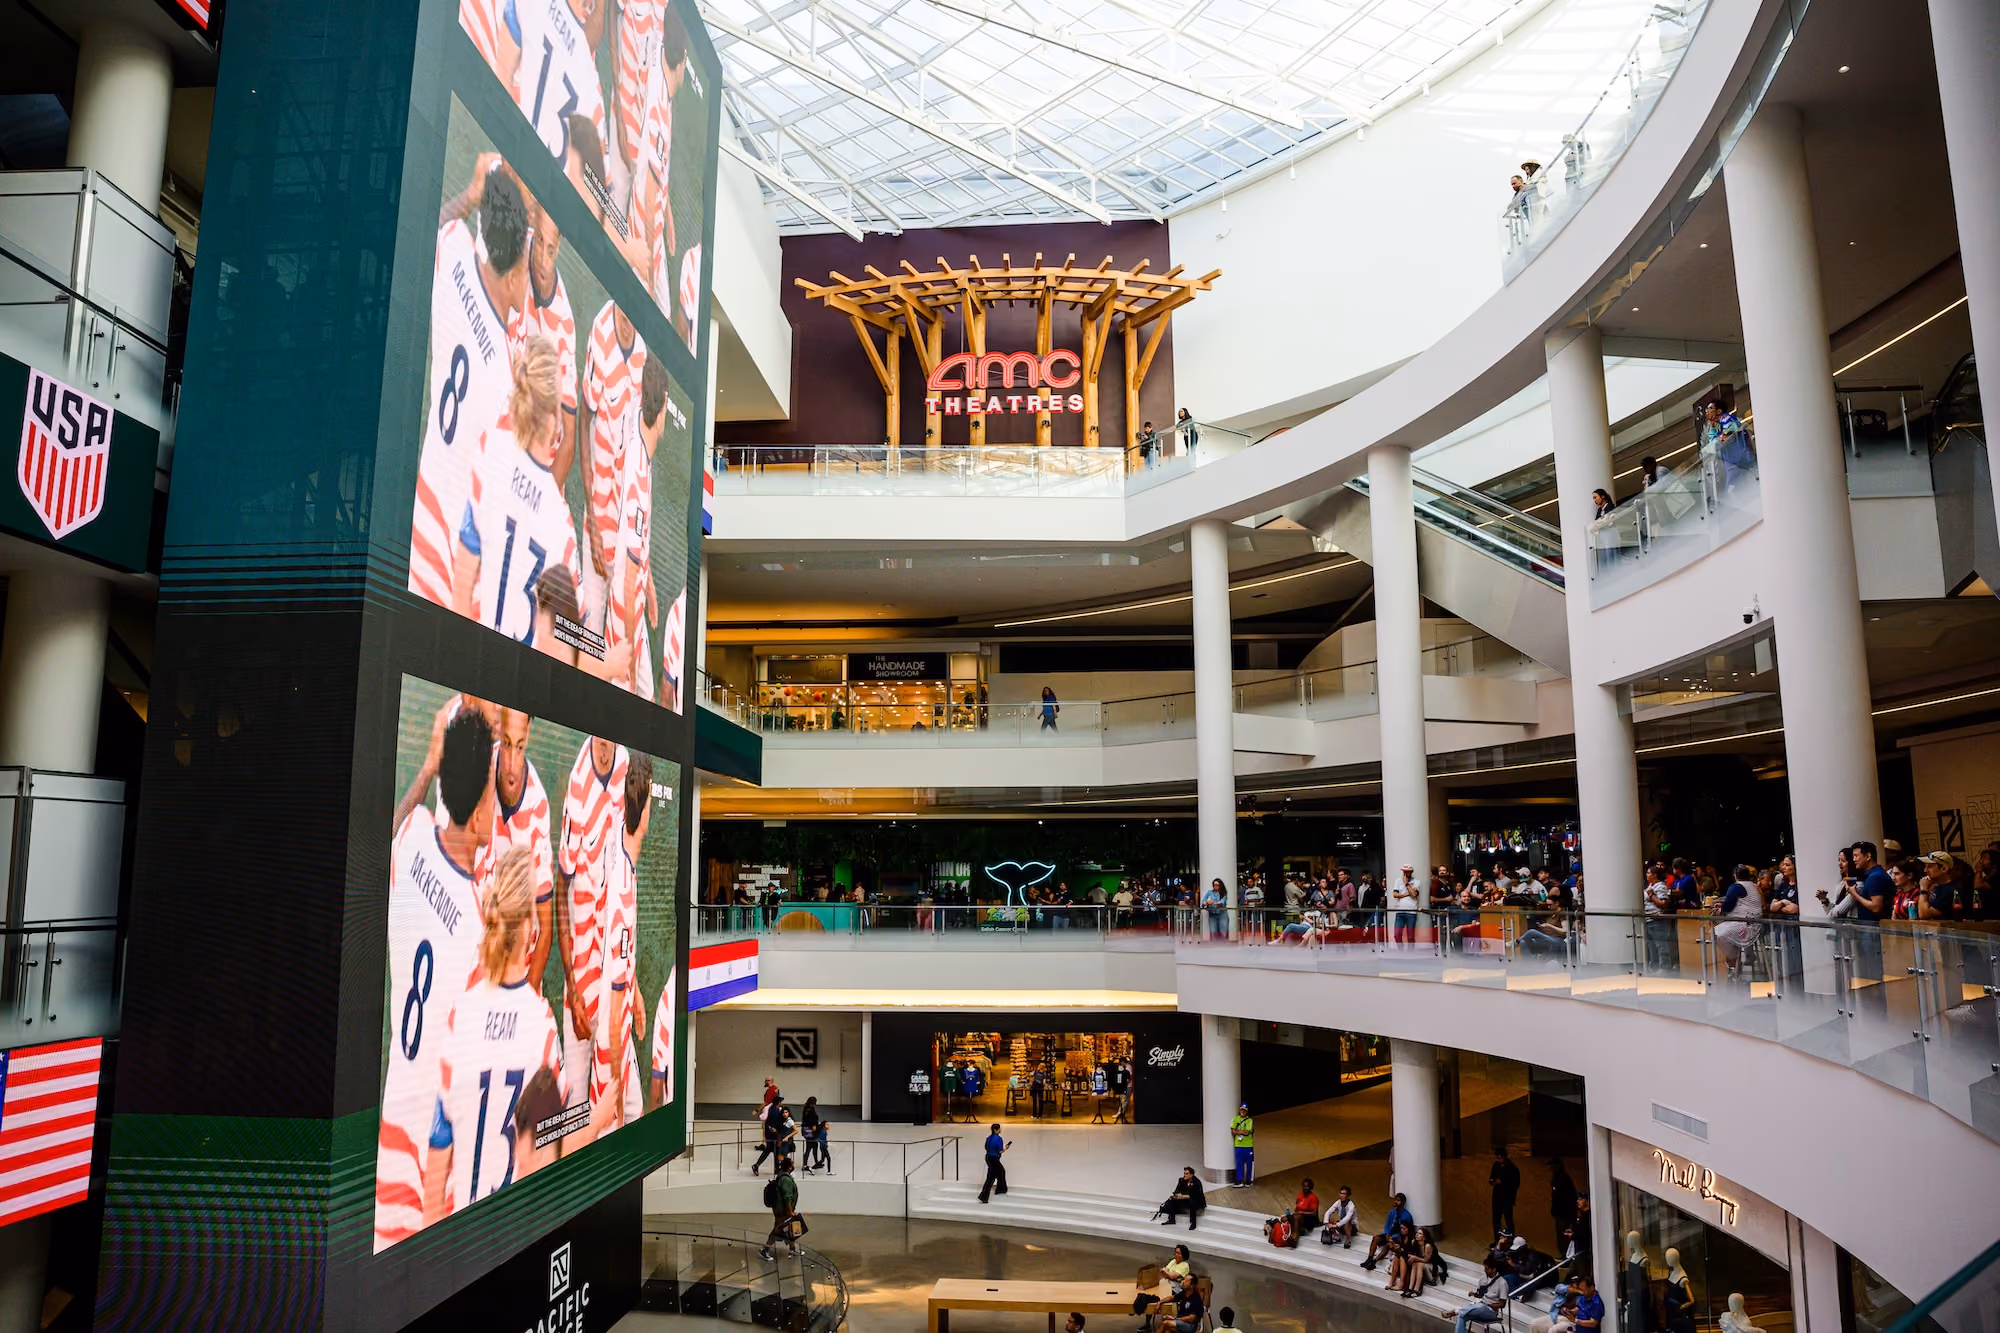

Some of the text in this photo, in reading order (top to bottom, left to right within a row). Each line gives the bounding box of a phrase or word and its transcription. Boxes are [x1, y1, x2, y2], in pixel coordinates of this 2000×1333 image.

[452, 260, 496, 366] McKENNIE
[32, 375, 108, 449] USA
[438, 343, 470, 446] 8
[925, 394, 1084, 416] THEATRES
[511, 466, 543, 514] REAM
[494, 514, 548, 648] 13
[869, 661, 925, 671] HANDMADE
[410, 850, 462, 936] McKENNIE
[401, 938, 434, 1061] 8
[484, 1010, 519, 1041] REAM
[1147, 1044, 1185, 1065] Simply
[469, 1067, 525, 1204] 13
[524, 1282, 590, 1333] ACIFIC
